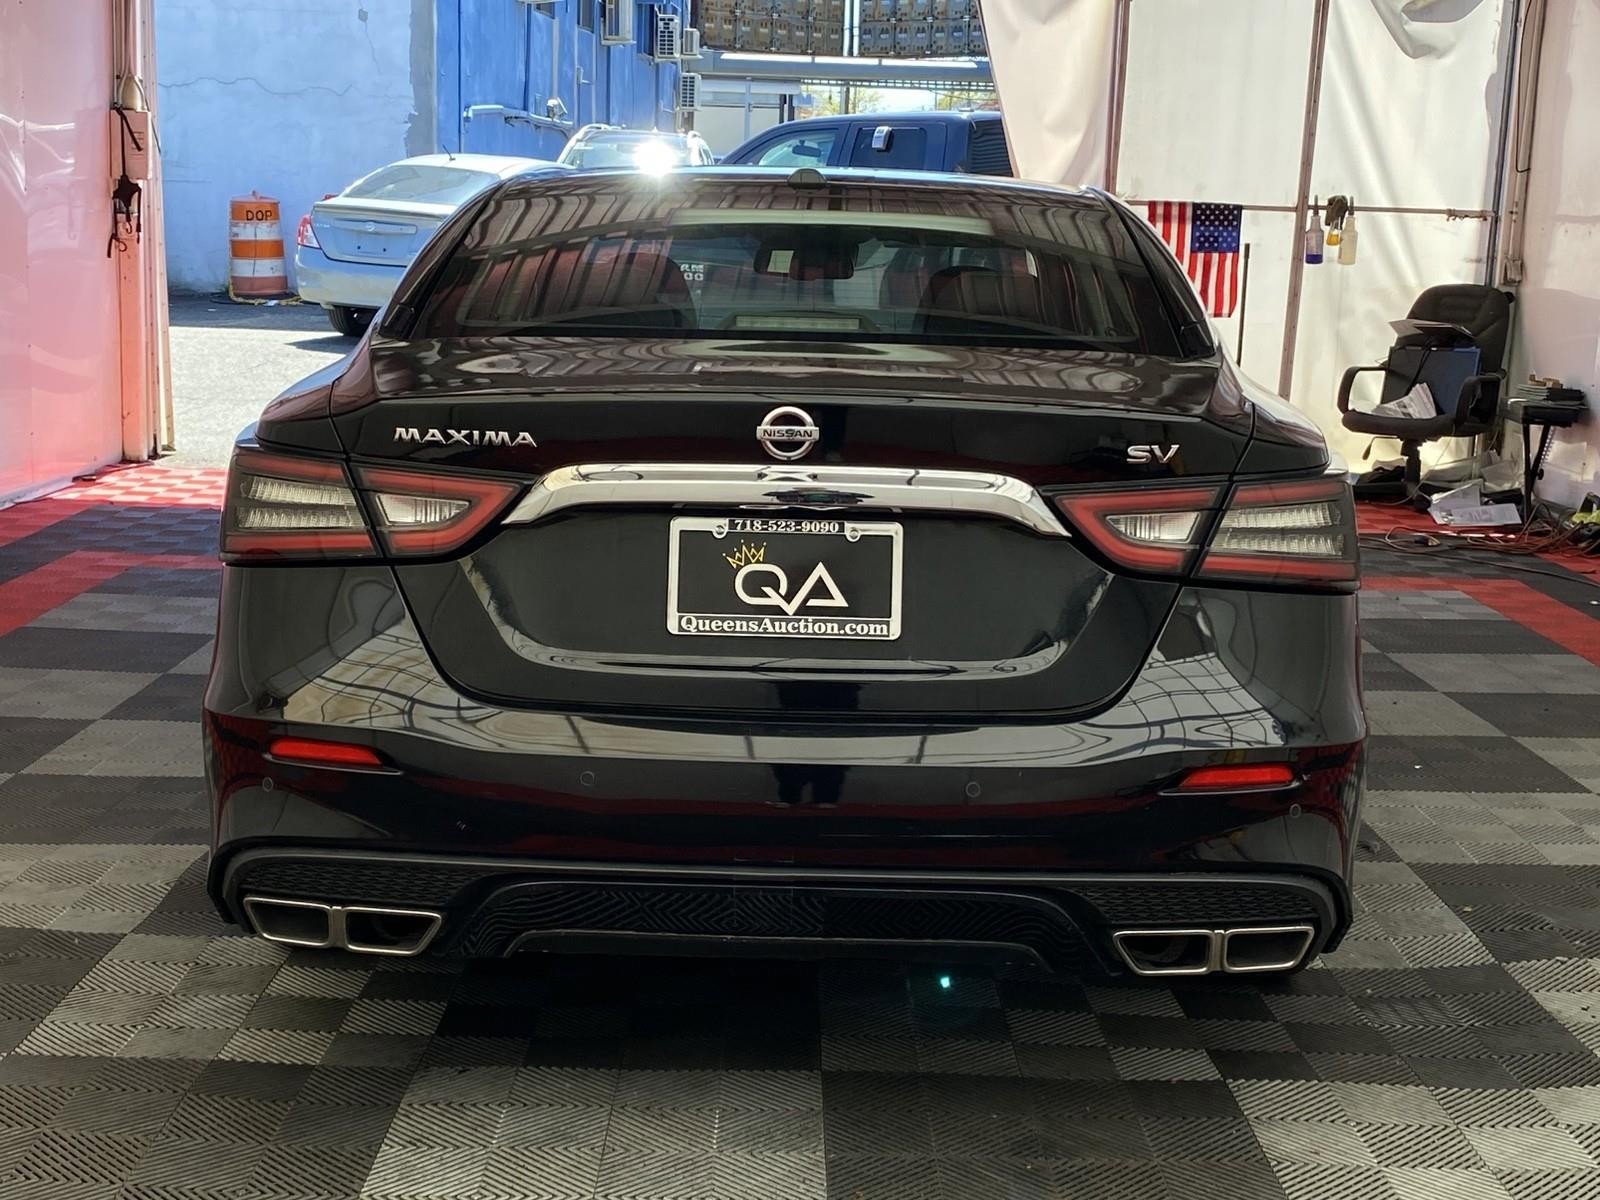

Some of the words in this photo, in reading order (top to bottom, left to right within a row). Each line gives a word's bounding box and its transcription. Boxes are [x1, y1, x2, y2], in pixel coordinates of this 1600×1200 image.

[246, 209, 273, 221] DOP
[393, 427, 538, 448] MAXIMA
[762, 429, 813, 438] NISSAN
[1126, 444, 1180, 464] SV
[733, 519, 840, 533] 718-523-9090
[734, 561, 849, 616] QA
[680, 615, 889, 636] QueensAuction.com
